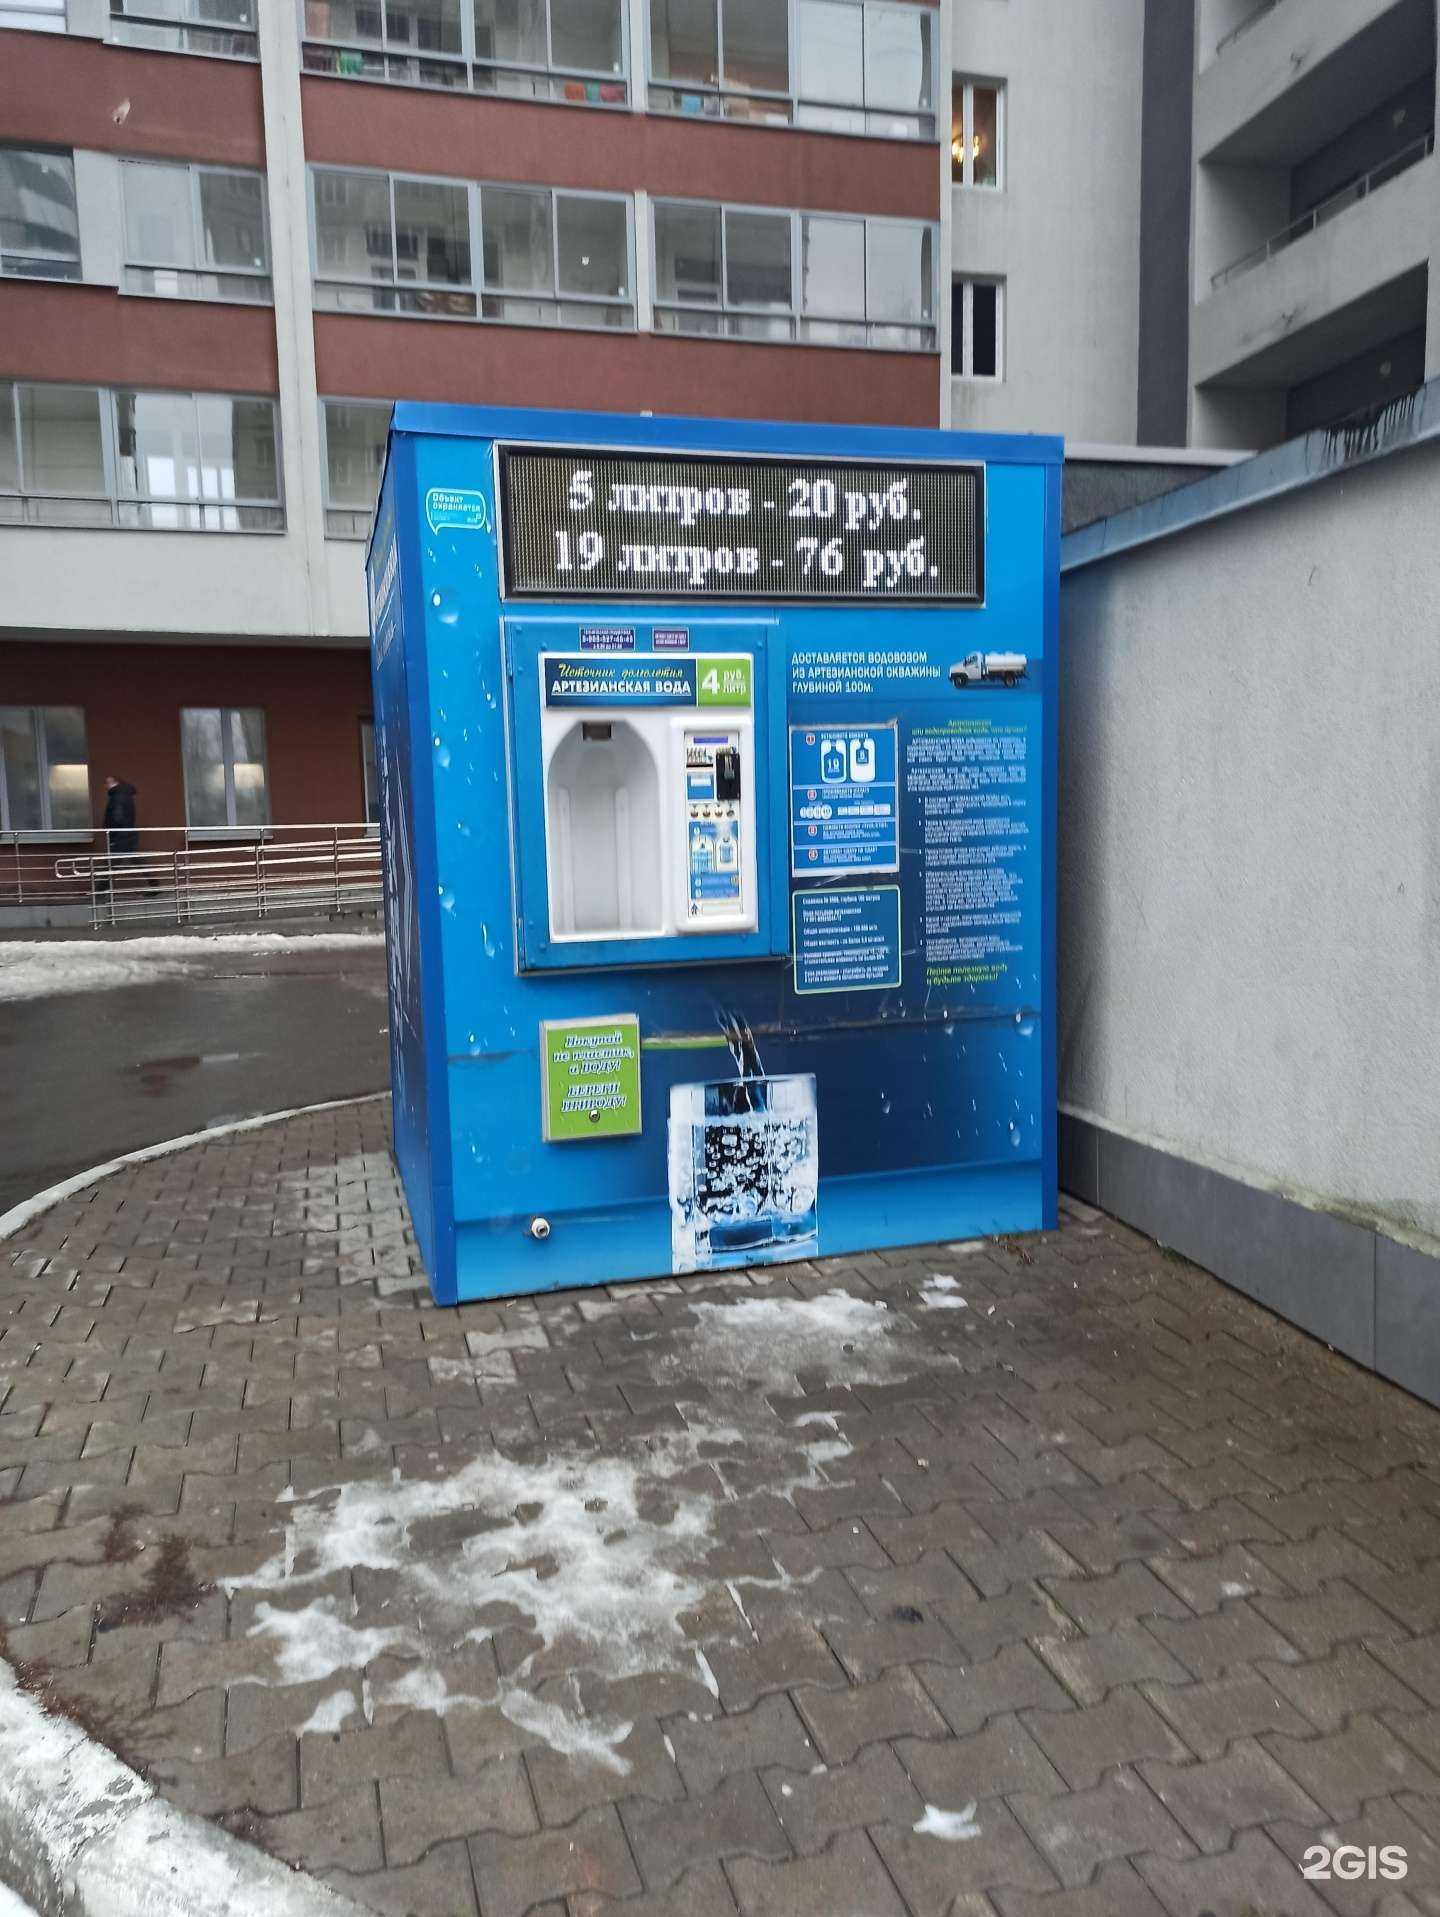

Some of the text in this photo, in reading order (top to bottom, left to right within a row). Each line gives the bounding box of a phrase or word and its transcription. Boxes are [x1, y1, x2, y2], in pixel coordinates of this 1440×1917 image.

[569, 470, 593, 510] 5
[609, 483, 750, 525] литров
[788, 478, 835, 517] 20
[844, 478, 921, 530] руб.
[555, 530, 603, 570] 19
[618, 544, 759, 584] литров
[796, 537, 843, 575] 76
[862, 535, 938, 588] руб.
[791, 651, 927, 665] ДОСТАВЛЯЕТСЯ ВОДОВОЗОМ
[558, 663, 684, 680] Источник долголетия
[793, 665, 941, 679] ИЗ АРТЕЗИАНСКОЙ СКВАЖИНЫ
[551, 680, 691, 694] АРТЕЗИАНСКАЯ ВОДА
[701, 668, 745, 695] 4 руб.
[792, 680, 842, 693] ГЛУБИНОЙ
[723, 682, 747, 696] литр
[565, 1031, 623, 1048] Покупай
[554, 1051, 570, 1062] не
[568, 1064, 579, 1075] а
[567, 1082, 620, 1097] БЕРЕГИ
[562, 1096, 627, 1112] ПРИРОДУ!
